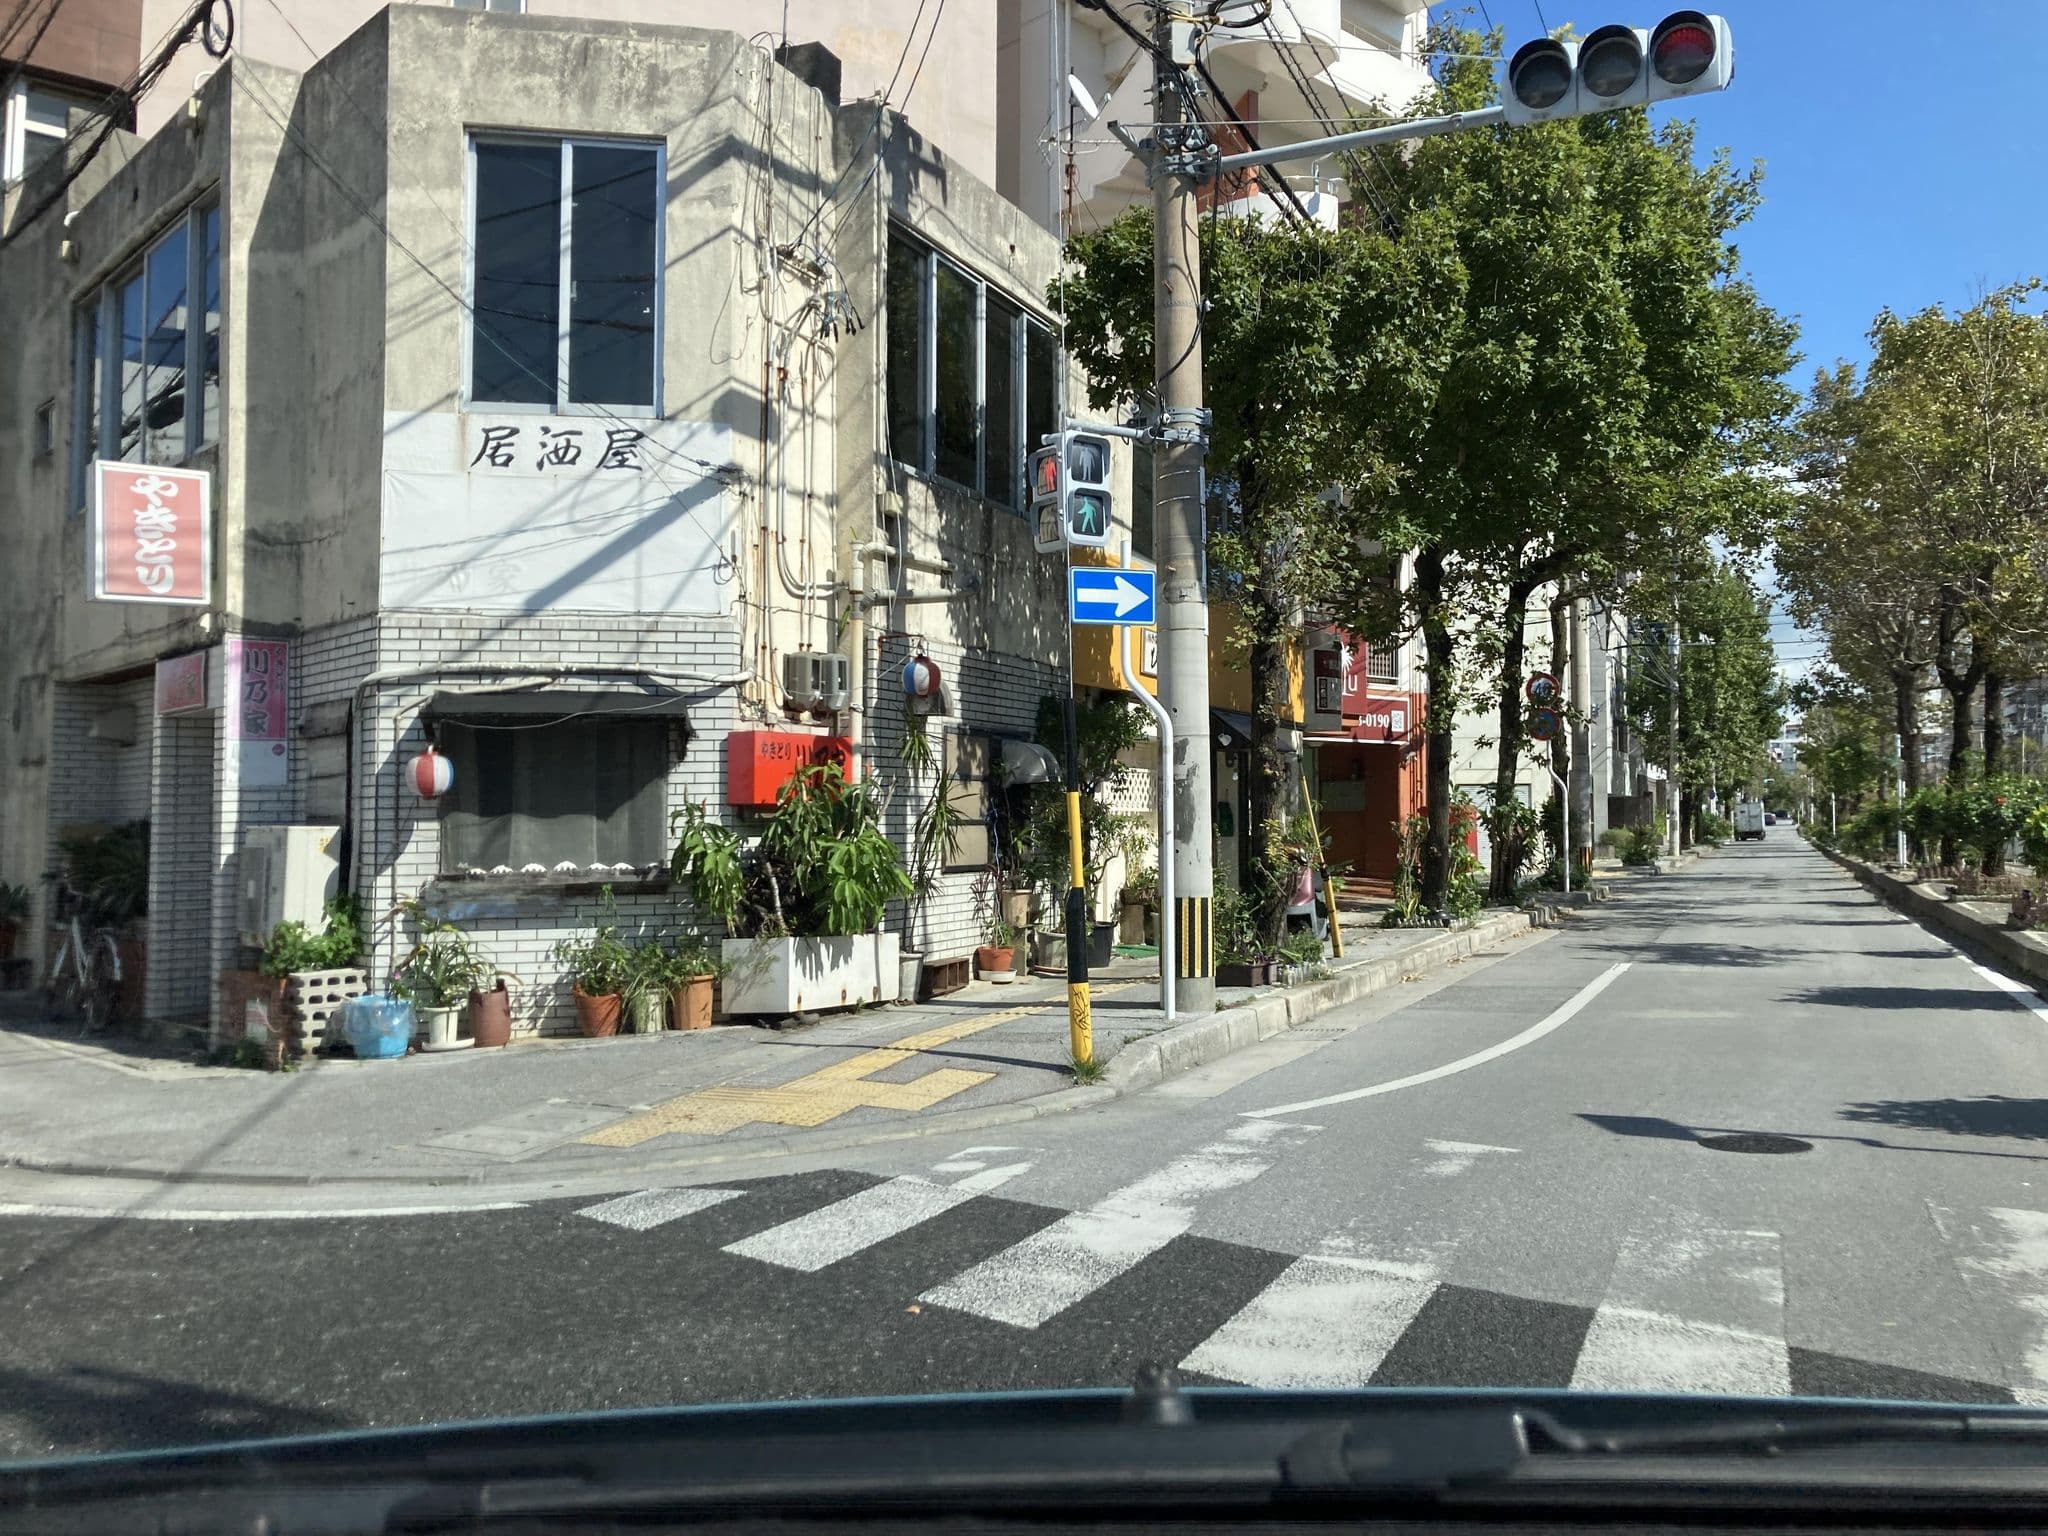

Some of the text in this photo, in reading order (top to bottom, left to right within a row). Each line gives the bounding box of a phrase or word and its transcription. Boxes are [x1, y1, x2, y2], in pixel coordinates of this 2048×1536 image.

[129, 474, 179, 594] やきとり
[760, 742, 791, 760] やきとり
